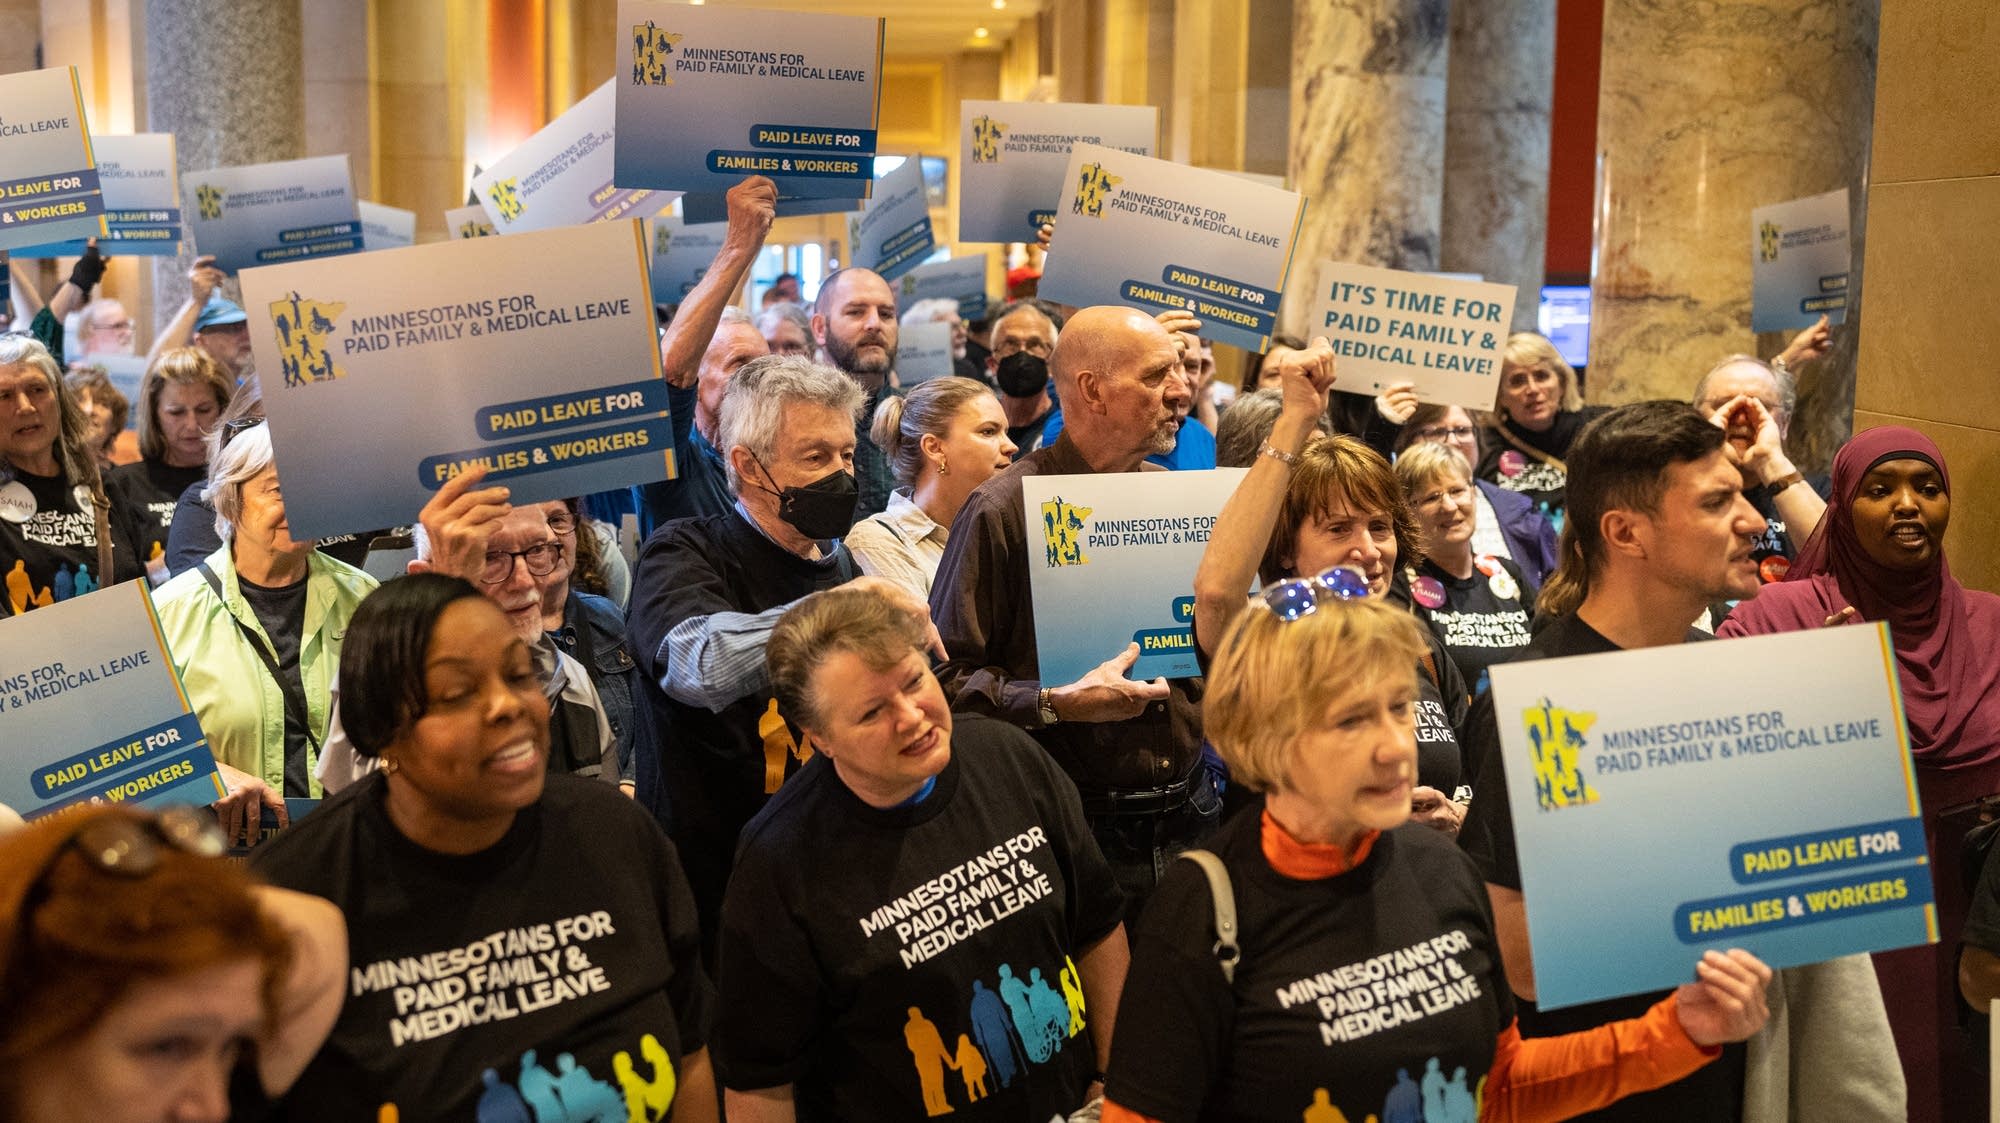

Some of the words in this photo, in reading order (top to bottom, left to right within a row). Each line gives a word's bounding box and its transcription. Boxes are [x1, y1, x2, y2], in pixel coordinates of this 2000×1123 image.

[676, 60, 706, 72] PAID
[710, 62, 755, 75] FAMILY
[758, 66, 767, 76] &
[770, 66, 825, 80] MEDICAL
[829, 69, 865, 82] LEAVE
[683, 48, 776, 64] MINNESOTANS
[780, 53, 804, 66] FOR
[0, 126, 27, 137] ICAL
[32, 118, 69, 132] LEAVE
[760, 131, 790, 144] PAID
[793, 132, 833, 145] LEAVE
[836, 134, 860, 146] FOR
[521, 144, 577, 187] MINNESOTANS
[578, 132, 596, 148] FOR
[522, 182, 540, 198] PAID
[540, 162, 574, 190] FAMILY
[576, 131, 612, 161] MEDICAL
[718, 156, 778, 170] FAMILIES
[782, 160, 792, 171] &
[795, 160, 858, 173] WORKERS
[1004, 144, 1027, 152] PAID
[1030, 144, 1062, 153] FAMILY
[9, 181, 51, 197] LEAVE
[54, 177, 81, 189] FOR
[1120, 190, 1200, 216] MINNESOTANS
[1204, 209, 1226, 222] FOR
[3, 212, 14, 223] &
[16, 202, 86, 220] WORKERS
[150, 212, 168, 220] FOR
[1112, 198, 1137, 213] PAID
[1140, 205, 1180, 223] FAMILY
[1182, 214, 1190, 224] &
[1193, 217, 1242, 238] MEDICAL
[1246, 232, 1280, 248] LEAVE
[122, 230, 170, 239] WORKERS
[1130, 286, 1185, 307] FAMILIES
[1186, 300, 1196, 311] &
[1198, 302, 1258, 327] WORKERS
[1172, 270, 1200, 286] PAID
[1202, 278, 1240, 296] LEAVE
[1240, 288, 1264, 304] FOR
[1330, 282, 1376, 305] IT'S
[1385, 289, 1446, 315] TIME
[1452, 298, 1502, 322] FOR
[344, 333, 389, 354] PAID
[396, 324, 464, 349] FAMILY
[470, 319, 482, 336] &
[488, 308, 570, 334] MEDICAL
[576, 298, 630, 323] LEAVE
[352, 300, 494, 336] MINNESOTANS
[499, 294, 536, 315] FOR
[1325, 312, 1380, 333] PAID
[1388, 320, 1474, 346] FAMILY
[1480, 332, 1496, 350] &
[1332, 340, 1416, 365] MEDICAL
[1424, 352, 1492, 374] LEAVE!
[490, 409, 536, 432] PAID
[542, 398, 601, 424] LEAVE
[606, 390, 644, 411] FOR
[436, 451, 528, 481] FAMILIES
[532, 448, 548, 464] &
[551, 430, 648, 460] WORKERS
[0, 497, 33, 510] SAIAH
[320, 534, 356, 546] LEAVE
[1089, 535, 1119, 548] PAID
[1123, 532, 1169, 546] FAMILY
[1172, 532, 1182, 543] &
[1094, 518, 1190, 534] MINNESOTANS
[1144, 634, 1194, 649] FAMILI
[11, 695, 23, 708] &
[26, 668, 99, 704] MEDICAL
[100, 650, 150, 677] LEAVE
[32, 662, 66, 685] FOR
[1434, 716, 1445, 728] &
[1603, 718, 1742, 751] MINNESOTANS
[1747, 711, 1785, 732] FOR
[44, 763, 87, 790] PAID
[89, 741, 145, 772] LEAVE
[145, 728, 182, 751] FOR
[1596, 752, 1642, 775] PAID
[1647, 742, 1714, 768] FAMILY
[1720, 741, 1732, 758] &
[1737, 728, 1820, 756] MEDICAL
[1826, 719, 1880, 743] LEAVE
[106, 760, 194, 802] WORKERS
[1744, 850, 1791, 874] PAID
[1796, 838, 1857, 866] LEAVE
[1861, 831, 1900, 856] FOR
[860, 846, 1010, 938] MINNESOTANS
[1005, 826, 1047, 860] FOR
[896, 905, 948, 944] PAID
[946, 864, 1019, 916] FAMILY
[1017, 859, 1038, 878] &
[899, 915, 994, 970] MEDICAL
[990, 874, 1052, 920] LEAVE
[1690, 900, 1785, 933] FAMILIES
[1788, 896, 1805, 917] &
[1806, 880, 1907, 912] WORKERS
[352, 924, 555, 996] MINNESOTANS
[556, 910, 616, 946] FOR
[1276, 942, 1436, 1008] MINNESOTANS
[1430, 930, 1471, 958] FOR
[393, 977, 466, 1015] PAID
[466, 949, 560, 993] FAMILY
[565, 945, 592, 972] &
[1318, 988, 1374, 1020] PAID
[1371, 962, 1448, 1004] FAMILY
[1446, 958, 1466, 978] &
[390, 996, 519, 1047] MEDICAL
[516, 967, 611, 1014] LEAVE
[1320, 1000, 1423, 1046] MEDICAL
[1419, 975, 1482, 1016] LEAVE
